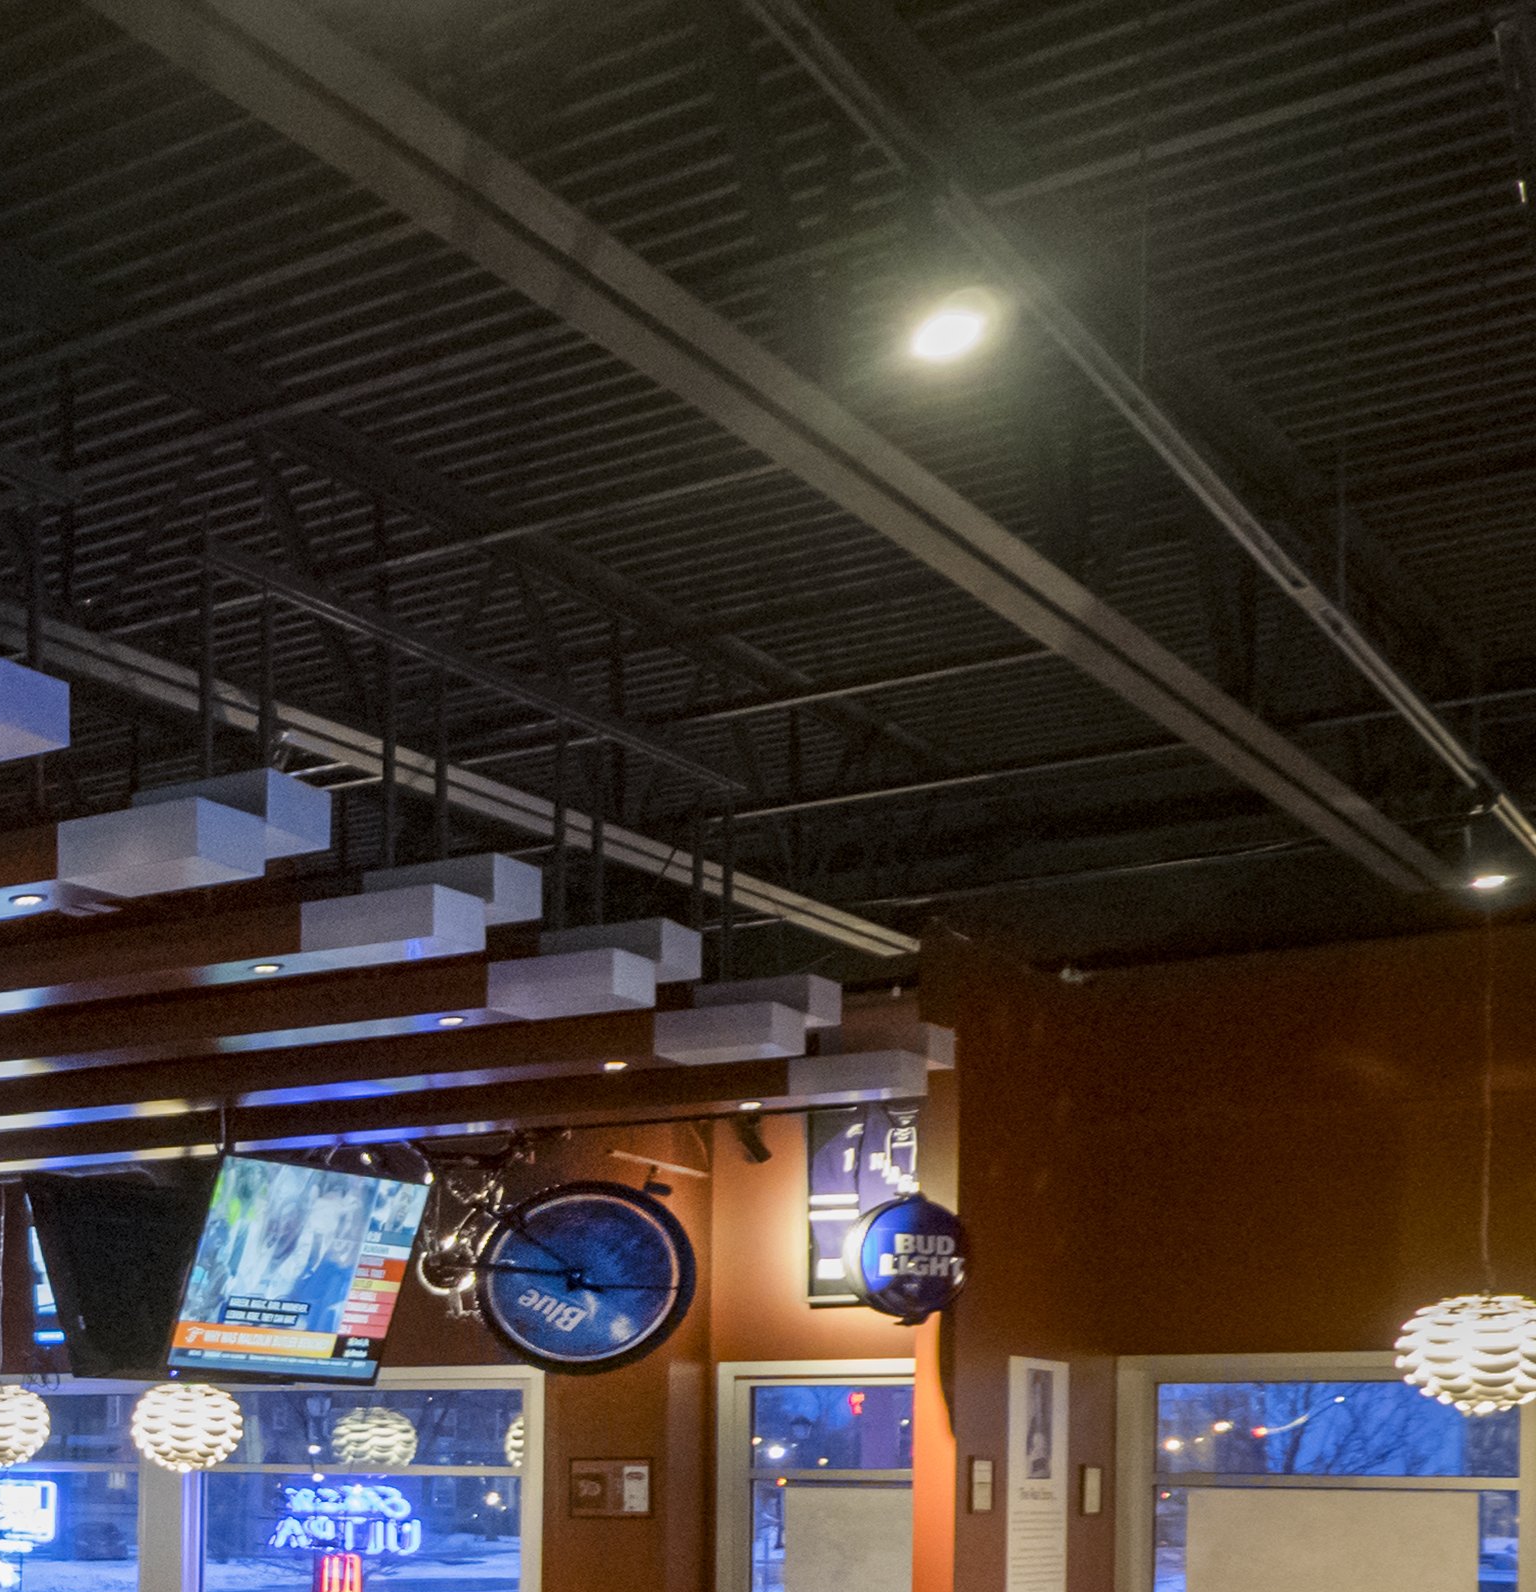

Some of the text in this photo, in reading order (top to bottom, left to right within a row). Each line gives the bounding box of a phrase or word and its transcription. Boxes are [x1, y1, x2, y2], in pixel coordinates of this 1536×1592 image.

[894, 1233, 956, 1255] BUD
[879, 1253, 965, 1284] LIGHT
[518, 1289, 588, 1332] Blue
